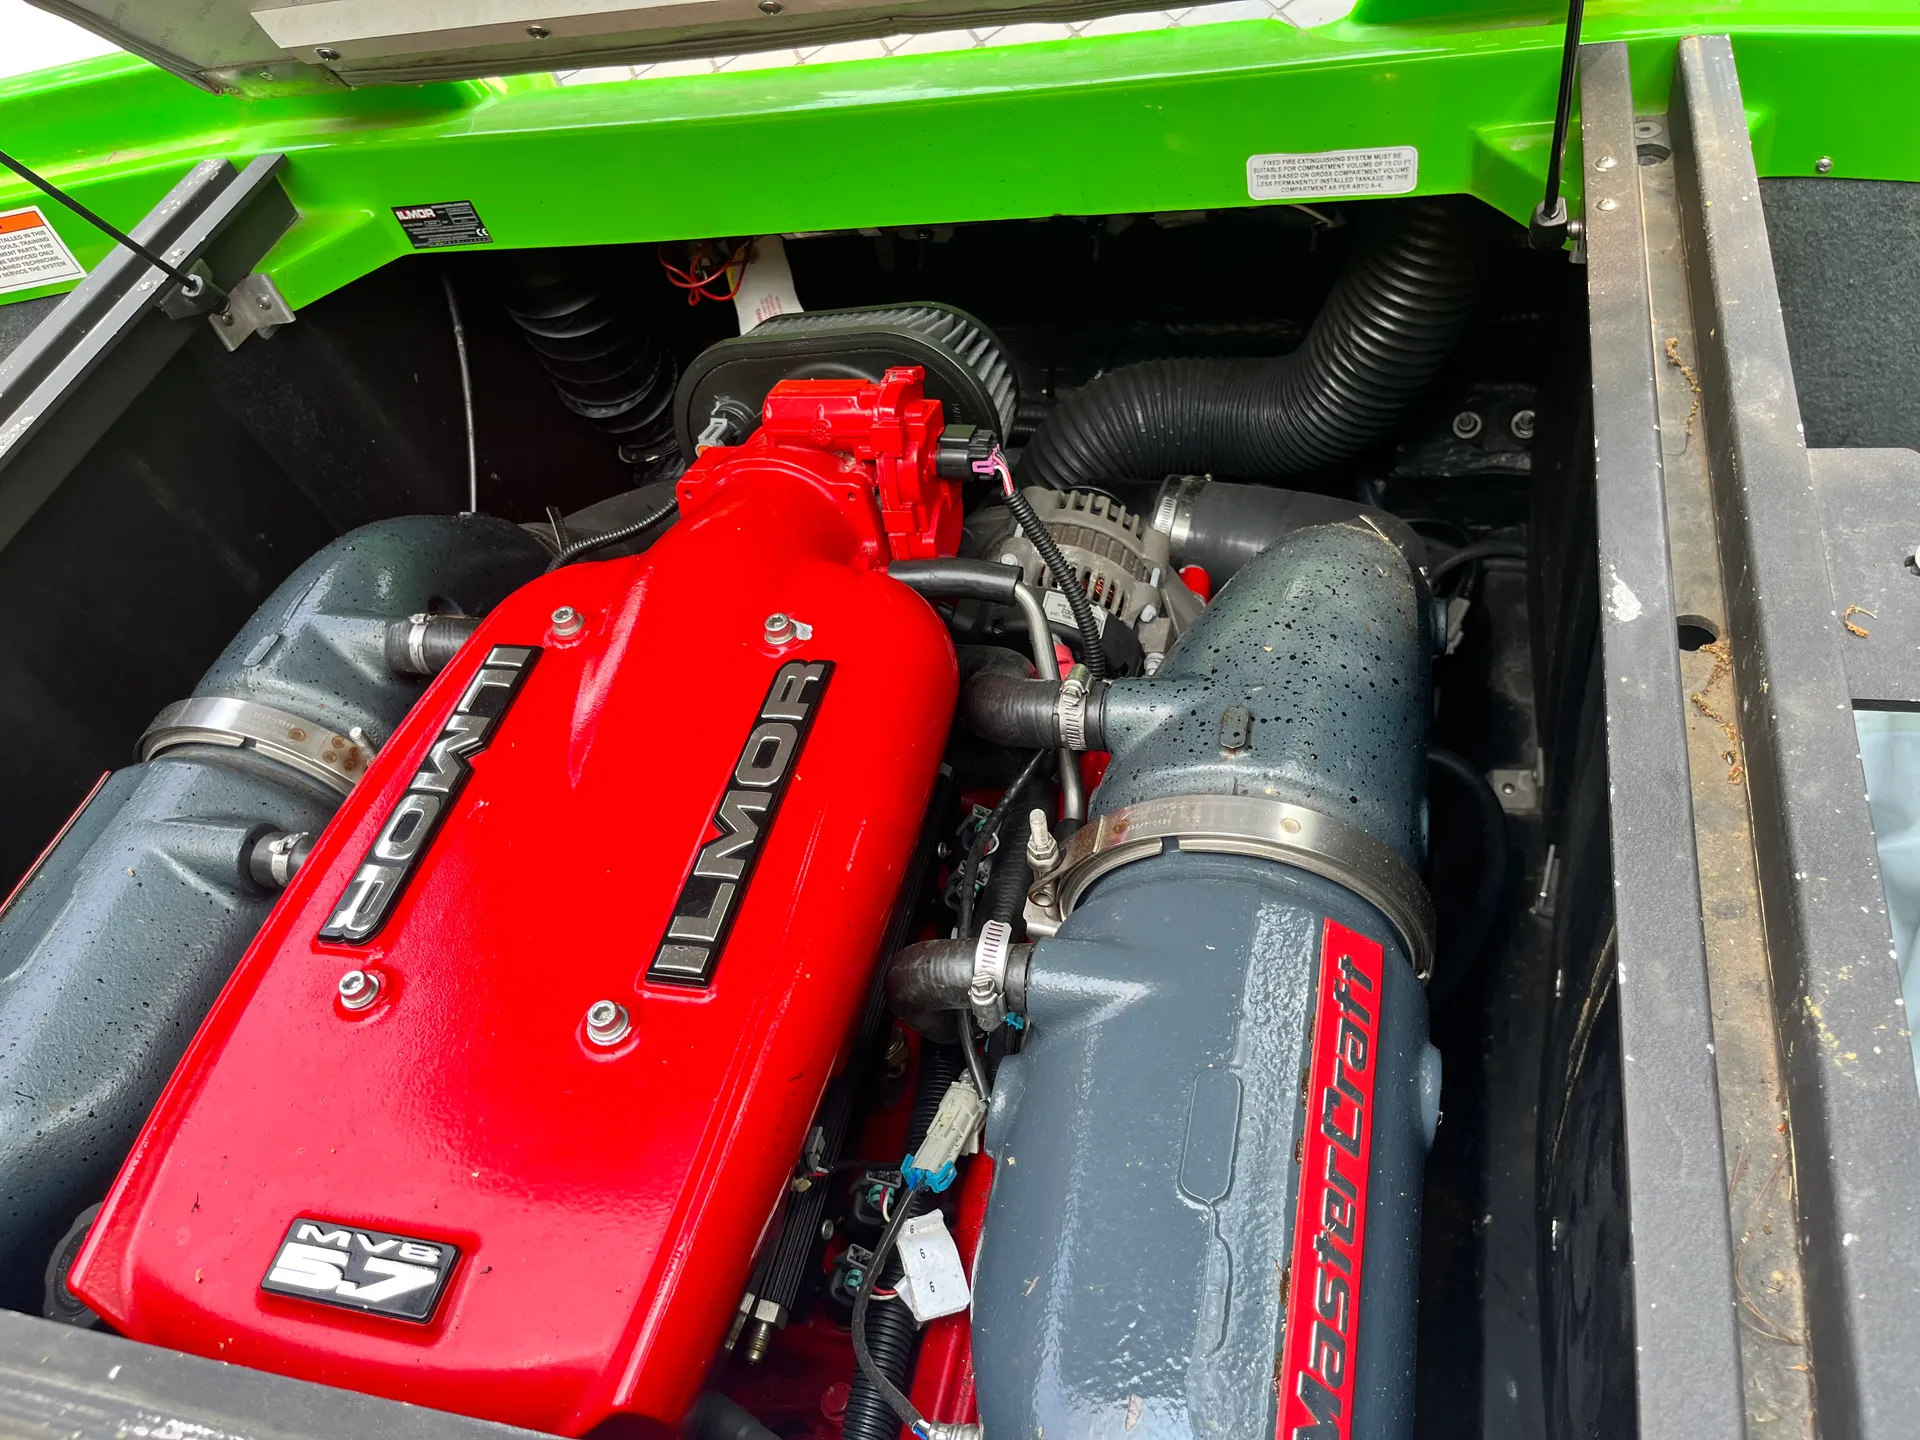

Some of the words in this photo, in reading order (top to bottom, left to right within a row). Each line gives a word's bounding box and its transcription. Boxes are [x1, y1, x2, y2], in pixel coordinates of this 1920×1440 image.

[1297, 156, 1346, 164] EXTINGUISHING
[1347, 154, 1372, 162] SYSTEM
[1297, 163, 1345, 172] COMPARTMENT
[1334, 168, 1382, 176] COMPARTMENT
[1274, 177, 1319, 186] PERMANENTLY
[1320, 176, 1354, 184] INSTALLED
[1355, 174, 1385, 182] TANKAGE
[1281, 185, 1328, 193] COMPARTMENT
[1352, 182, 1370, 190] ABYC
[395, 207, 437, 221] ILMOR
[327, 647, 532, 932] ILMOR
[654, 662, 825, 973] ILMOR
[1292, 954, 1373, 1440] MasterCraft
[909, 1225, 915, 1234] 6
[296, 1223, 443, 1264] MV8
[919, 1248, 926, 1259] 6
[929, 1281, 936, 1293] 6
